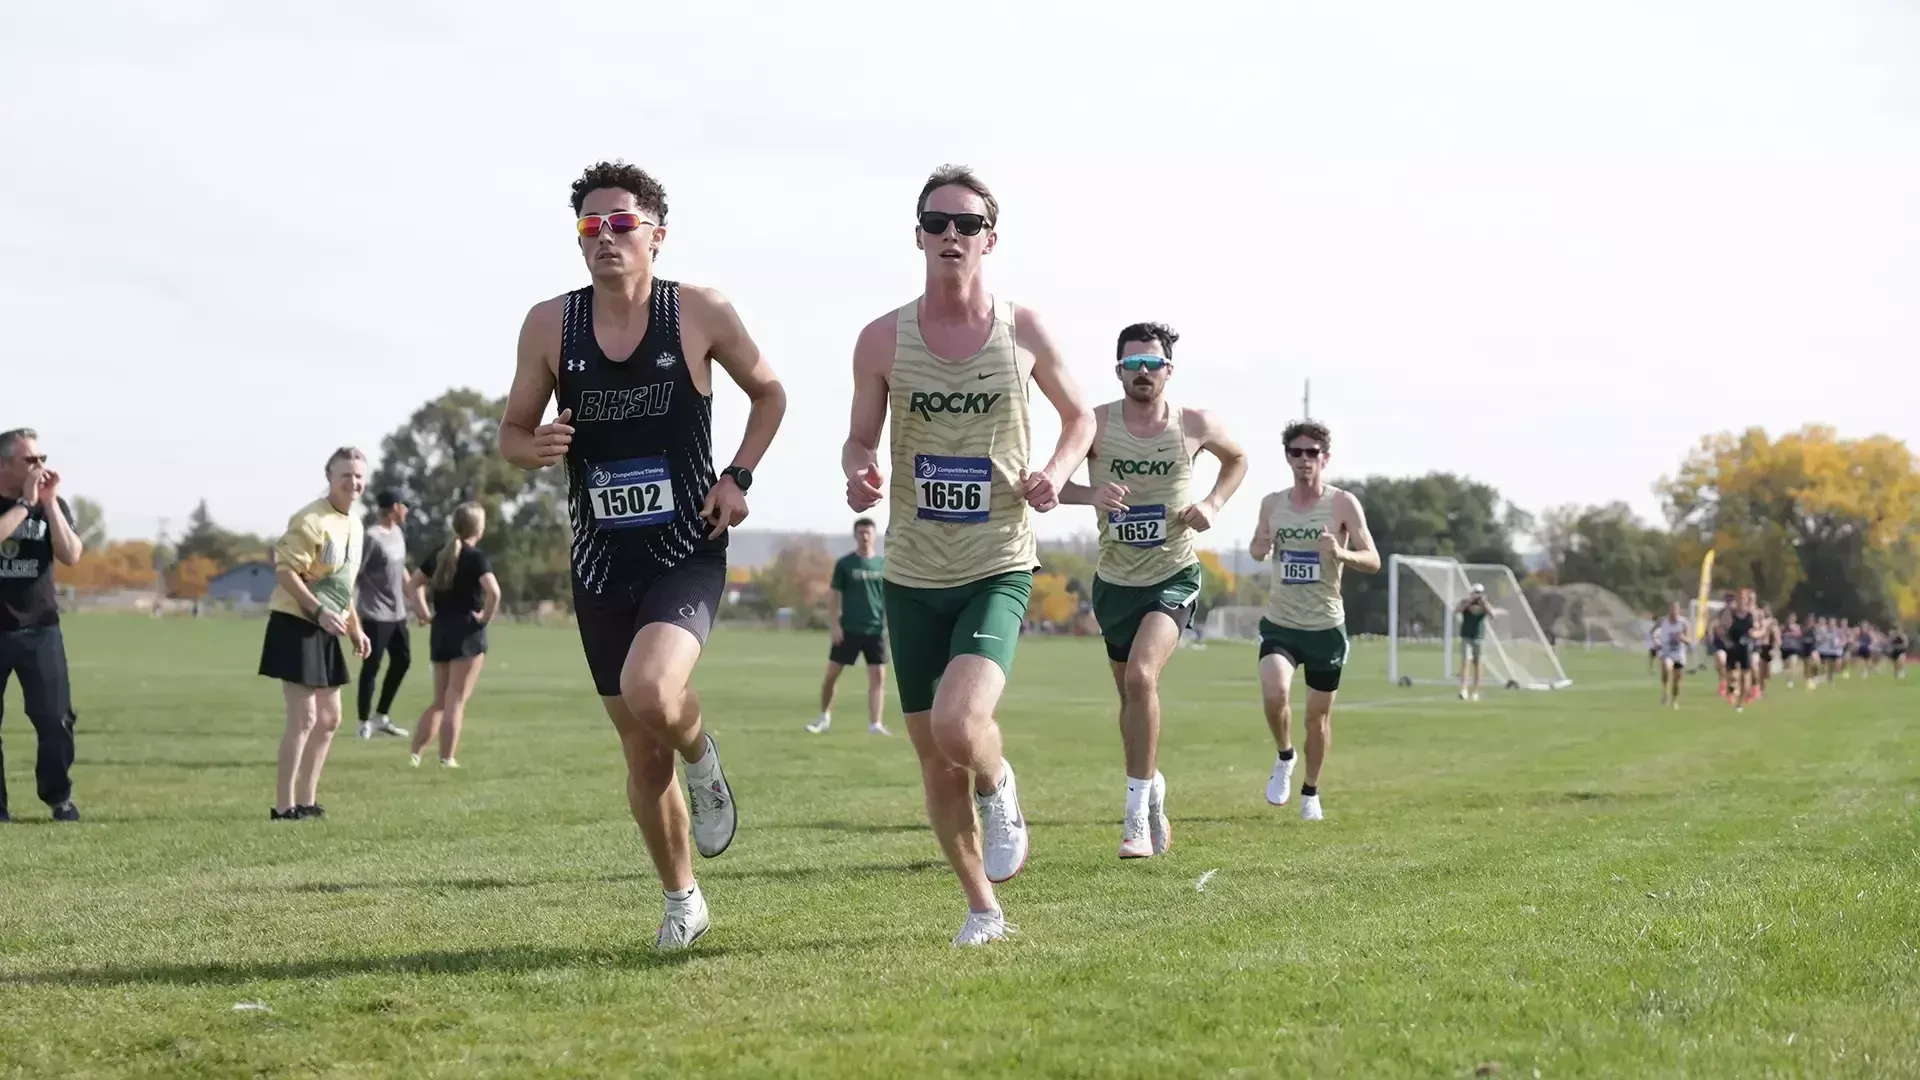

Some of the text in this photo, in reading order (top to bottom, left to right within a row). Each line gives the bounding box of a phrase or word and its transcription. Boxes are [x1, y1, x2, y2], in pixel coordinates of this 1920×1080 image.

[577, 381, 674, 421] BHSU
[910, 391, 1002, 422] ROCKY
[612, 470, 644, 479] Competitive
[643, 467, 664, 475] Timing
[937, 466, 969, 474] Competitive
[969, 467, 988, 475] Timing
[1110, 458, 1176, 480] ROCKY
[597, 483, 663, 516] 1502
[921, 481, 981, 510] 1656
[1116, 521, 1159, 541] 1652
[1276, 528, 1322, 544] ROCKY
[1284, 564, 1313, 579] 1651
